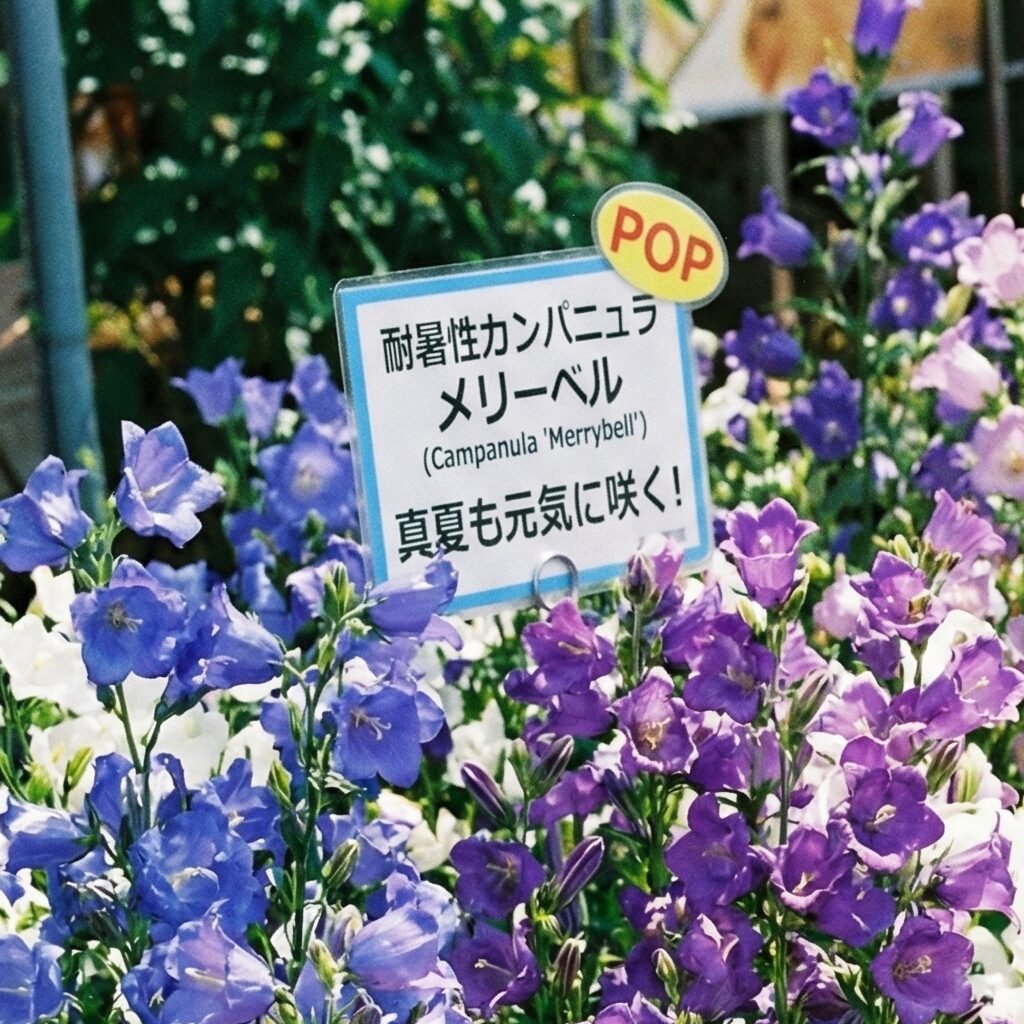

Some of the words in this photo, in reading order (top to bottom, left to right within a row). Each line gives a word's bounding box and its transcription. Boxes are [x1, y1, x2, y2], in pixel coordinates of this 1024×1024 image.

[609, 204, 715, 282] POP
[380, 293, 658, 374] 耐暑性カンパニュラ
[438, 355, 623, 433] メリーベル
[423, 431, 538, 477] (Campanula
[543, 410, 648, 457] 'Merrybell')
[395, 464, 683, 563] 真夏も元気に咲く!
